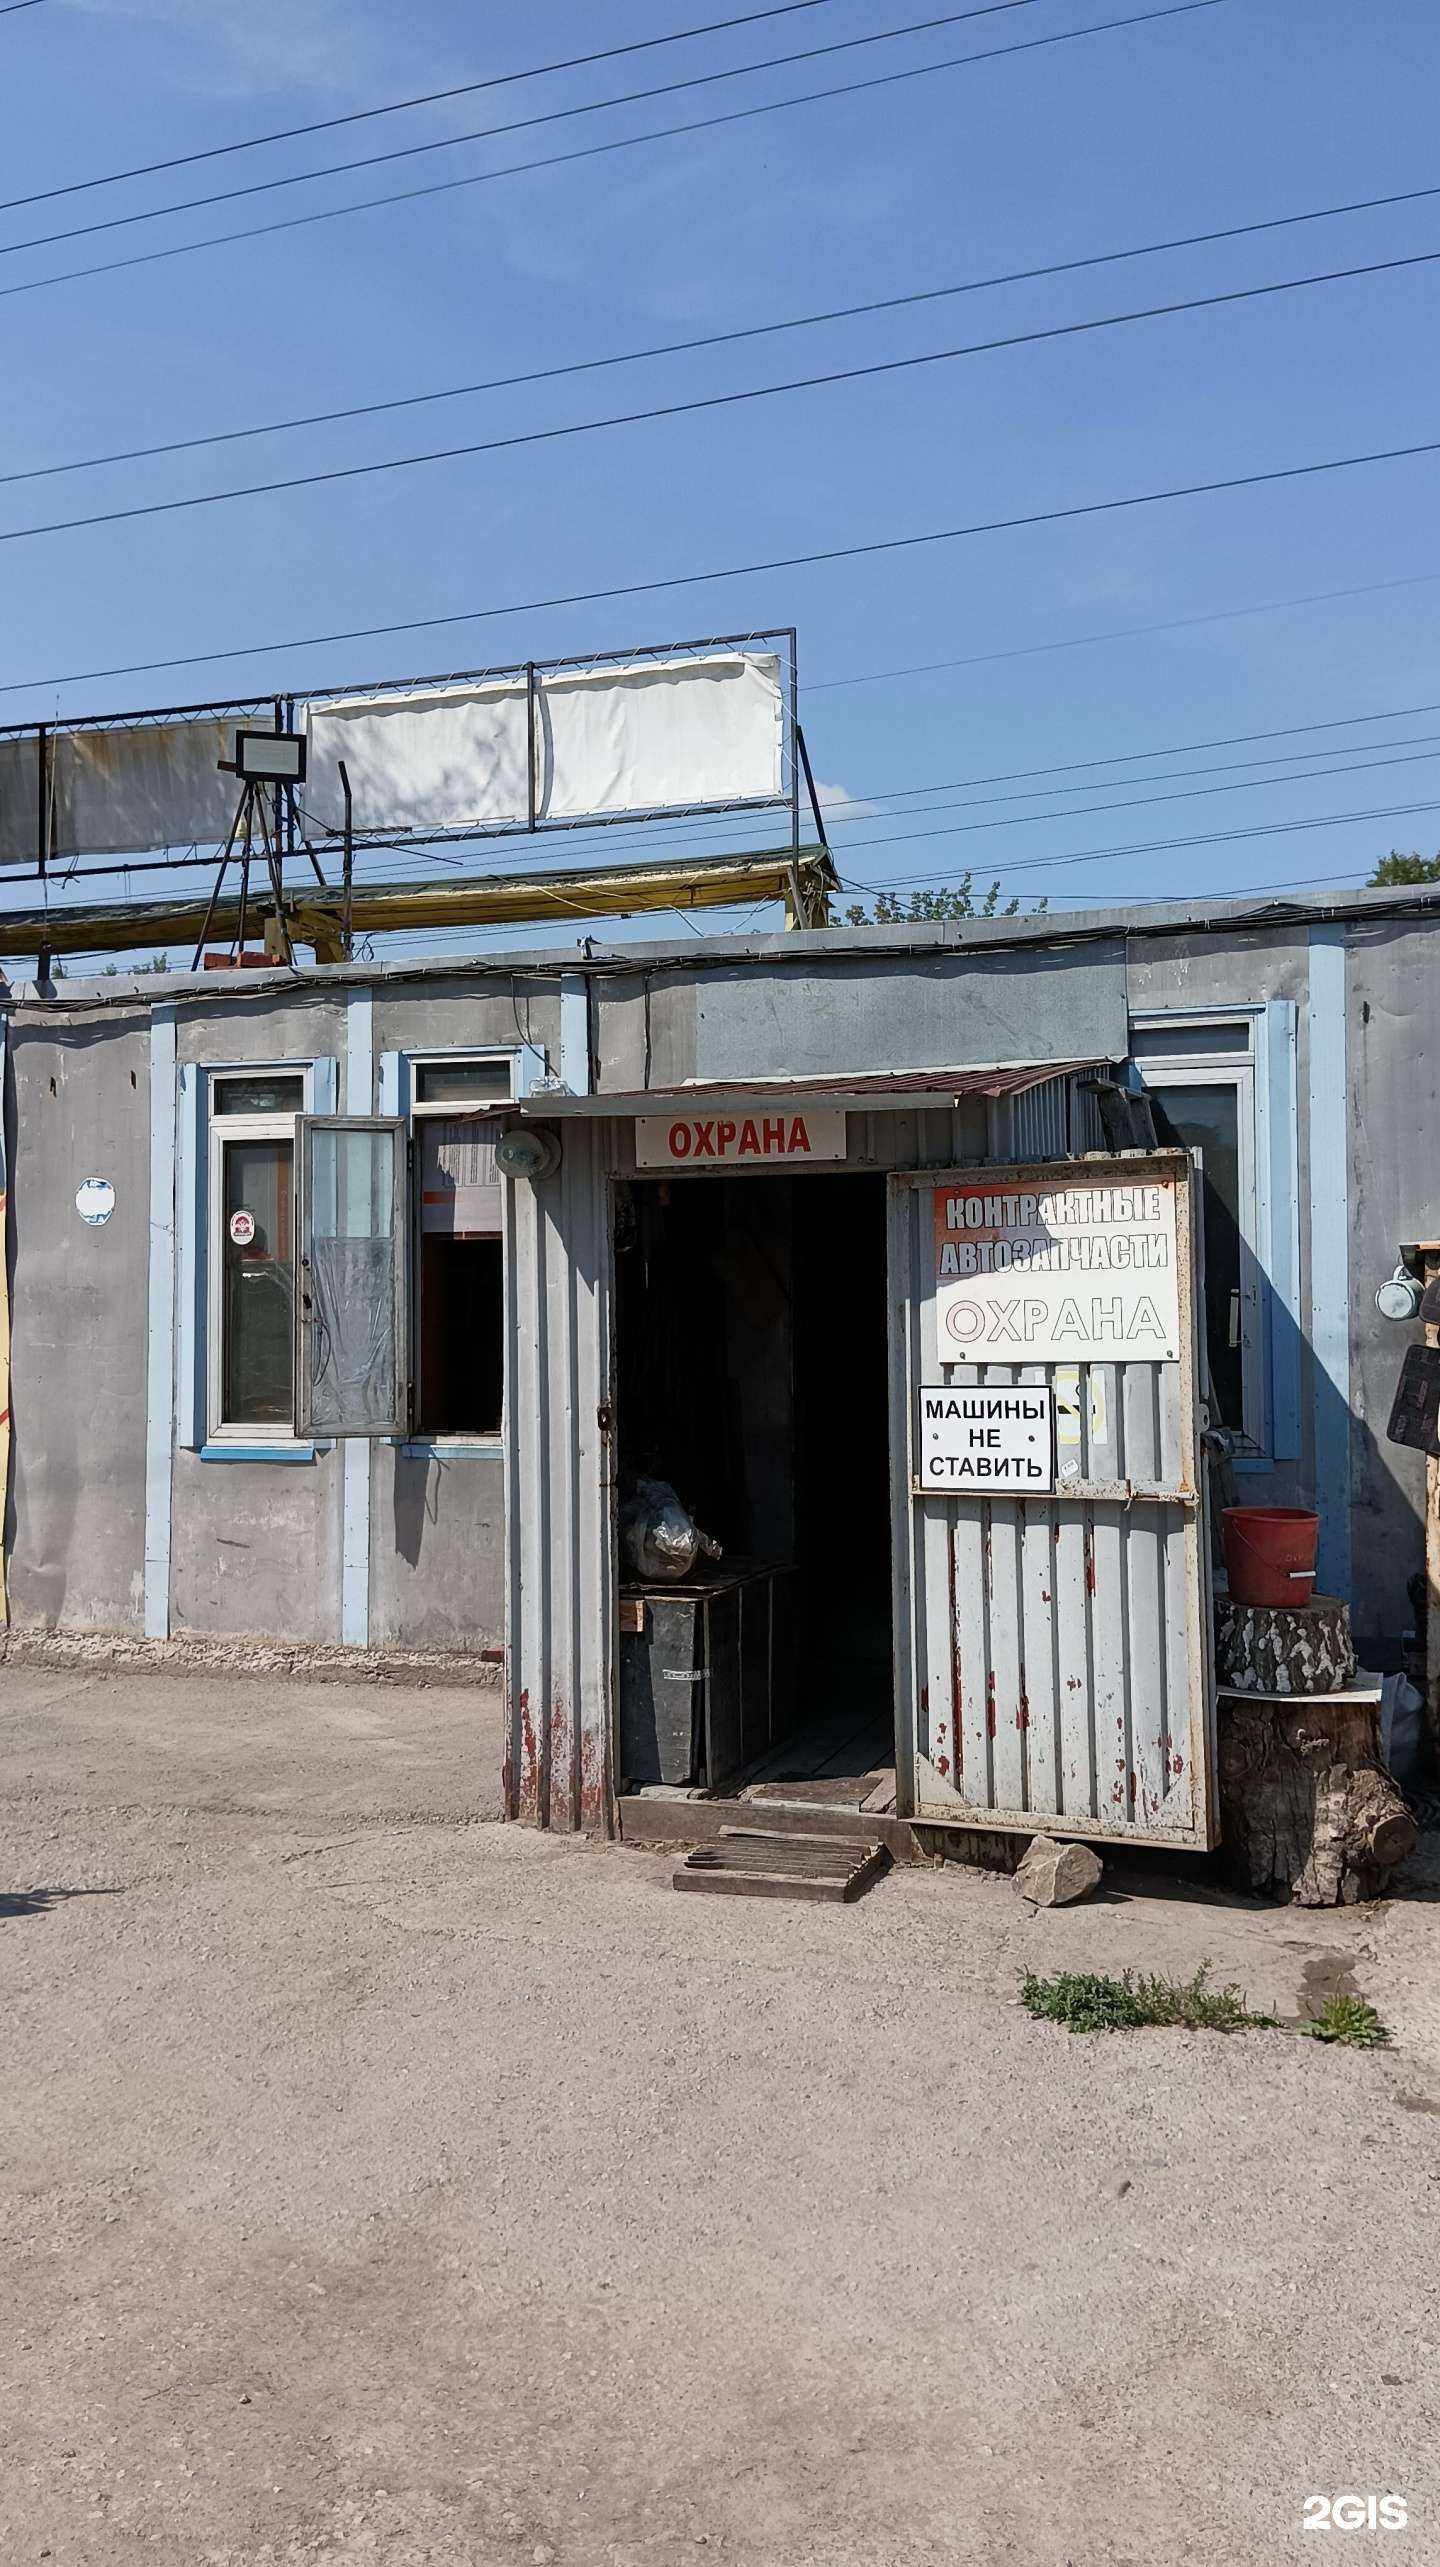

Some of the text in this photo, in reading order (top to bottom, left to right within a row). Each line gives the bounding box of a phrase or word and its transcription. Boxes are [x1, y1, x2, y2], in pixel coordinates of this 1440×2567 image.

[668, 1117, 811, 1158] ОХРАНА
[946, 1187, 1160, 1230] КОНТРАКТНЫЕ
[939, 1234, 1168, 1275] АВТОЗАПЧАСТИ
[946, 1296, 1167, 1343] ОХРАНА
[926, 1400, 1044, 1419] МАШИНЫ
[969, 1429, 1001, 1448] НЕ
[929, 1457, 1042, 1477] СТАВИТЬ
